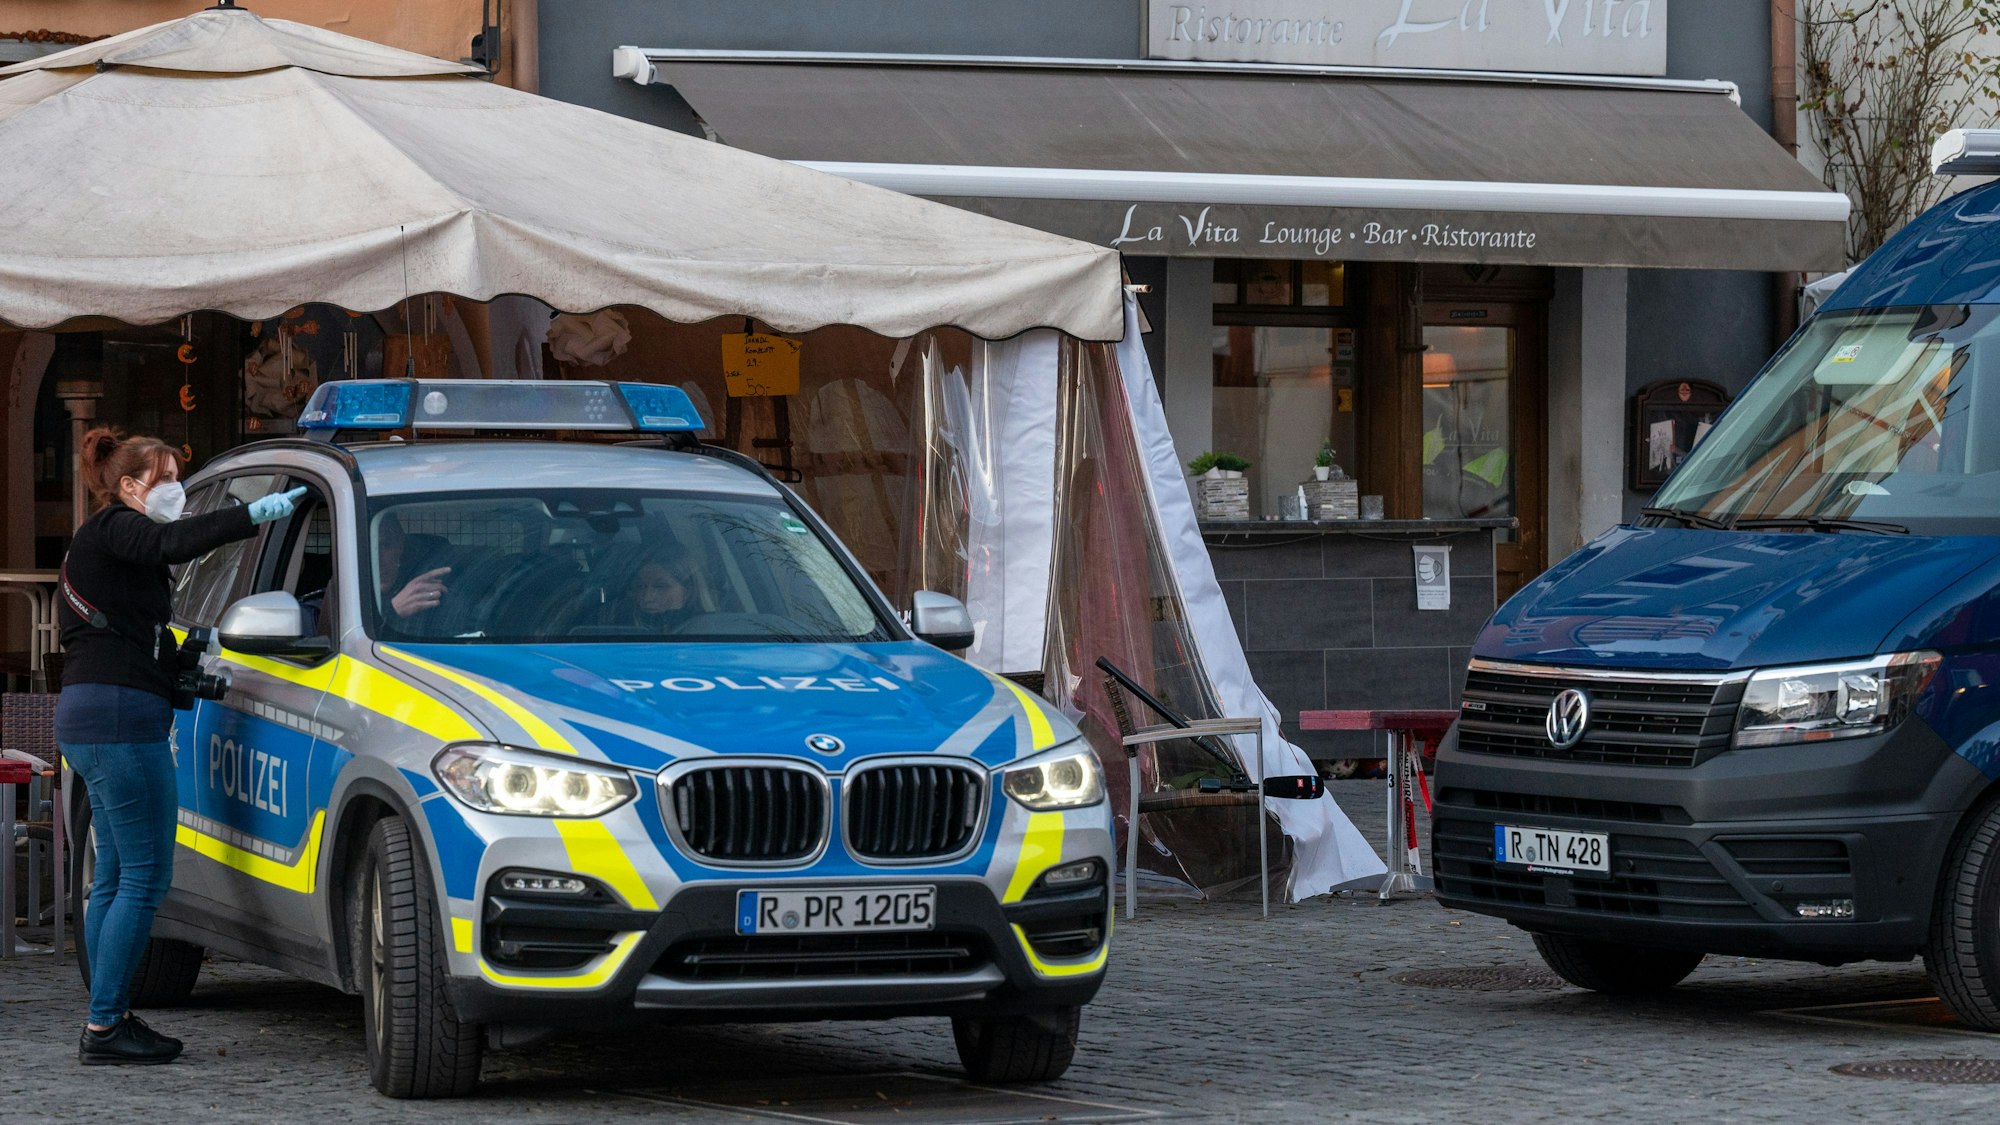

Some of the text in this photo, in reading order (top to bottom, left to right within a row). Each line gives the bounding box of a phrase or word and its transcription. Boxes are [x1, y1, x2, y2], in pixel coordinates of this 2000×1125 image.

[1166, 5, 1344, 46] Ristorante
[1110, 204, 1536, 256] La Vita Lounge Bar Ristorante
[608, 676, 900, 693] POLIZEI
[210, 733, 288, 818] POLIZEI
[1511, 831, 1523, 859] R
[1535, 833, 1559, 862] TN
[1566, 836, 1601, 866] 428
[760, 897, 779, 928] R
[804, 896, 844, 927] PR
[853, 893, 932, 927] 1205
